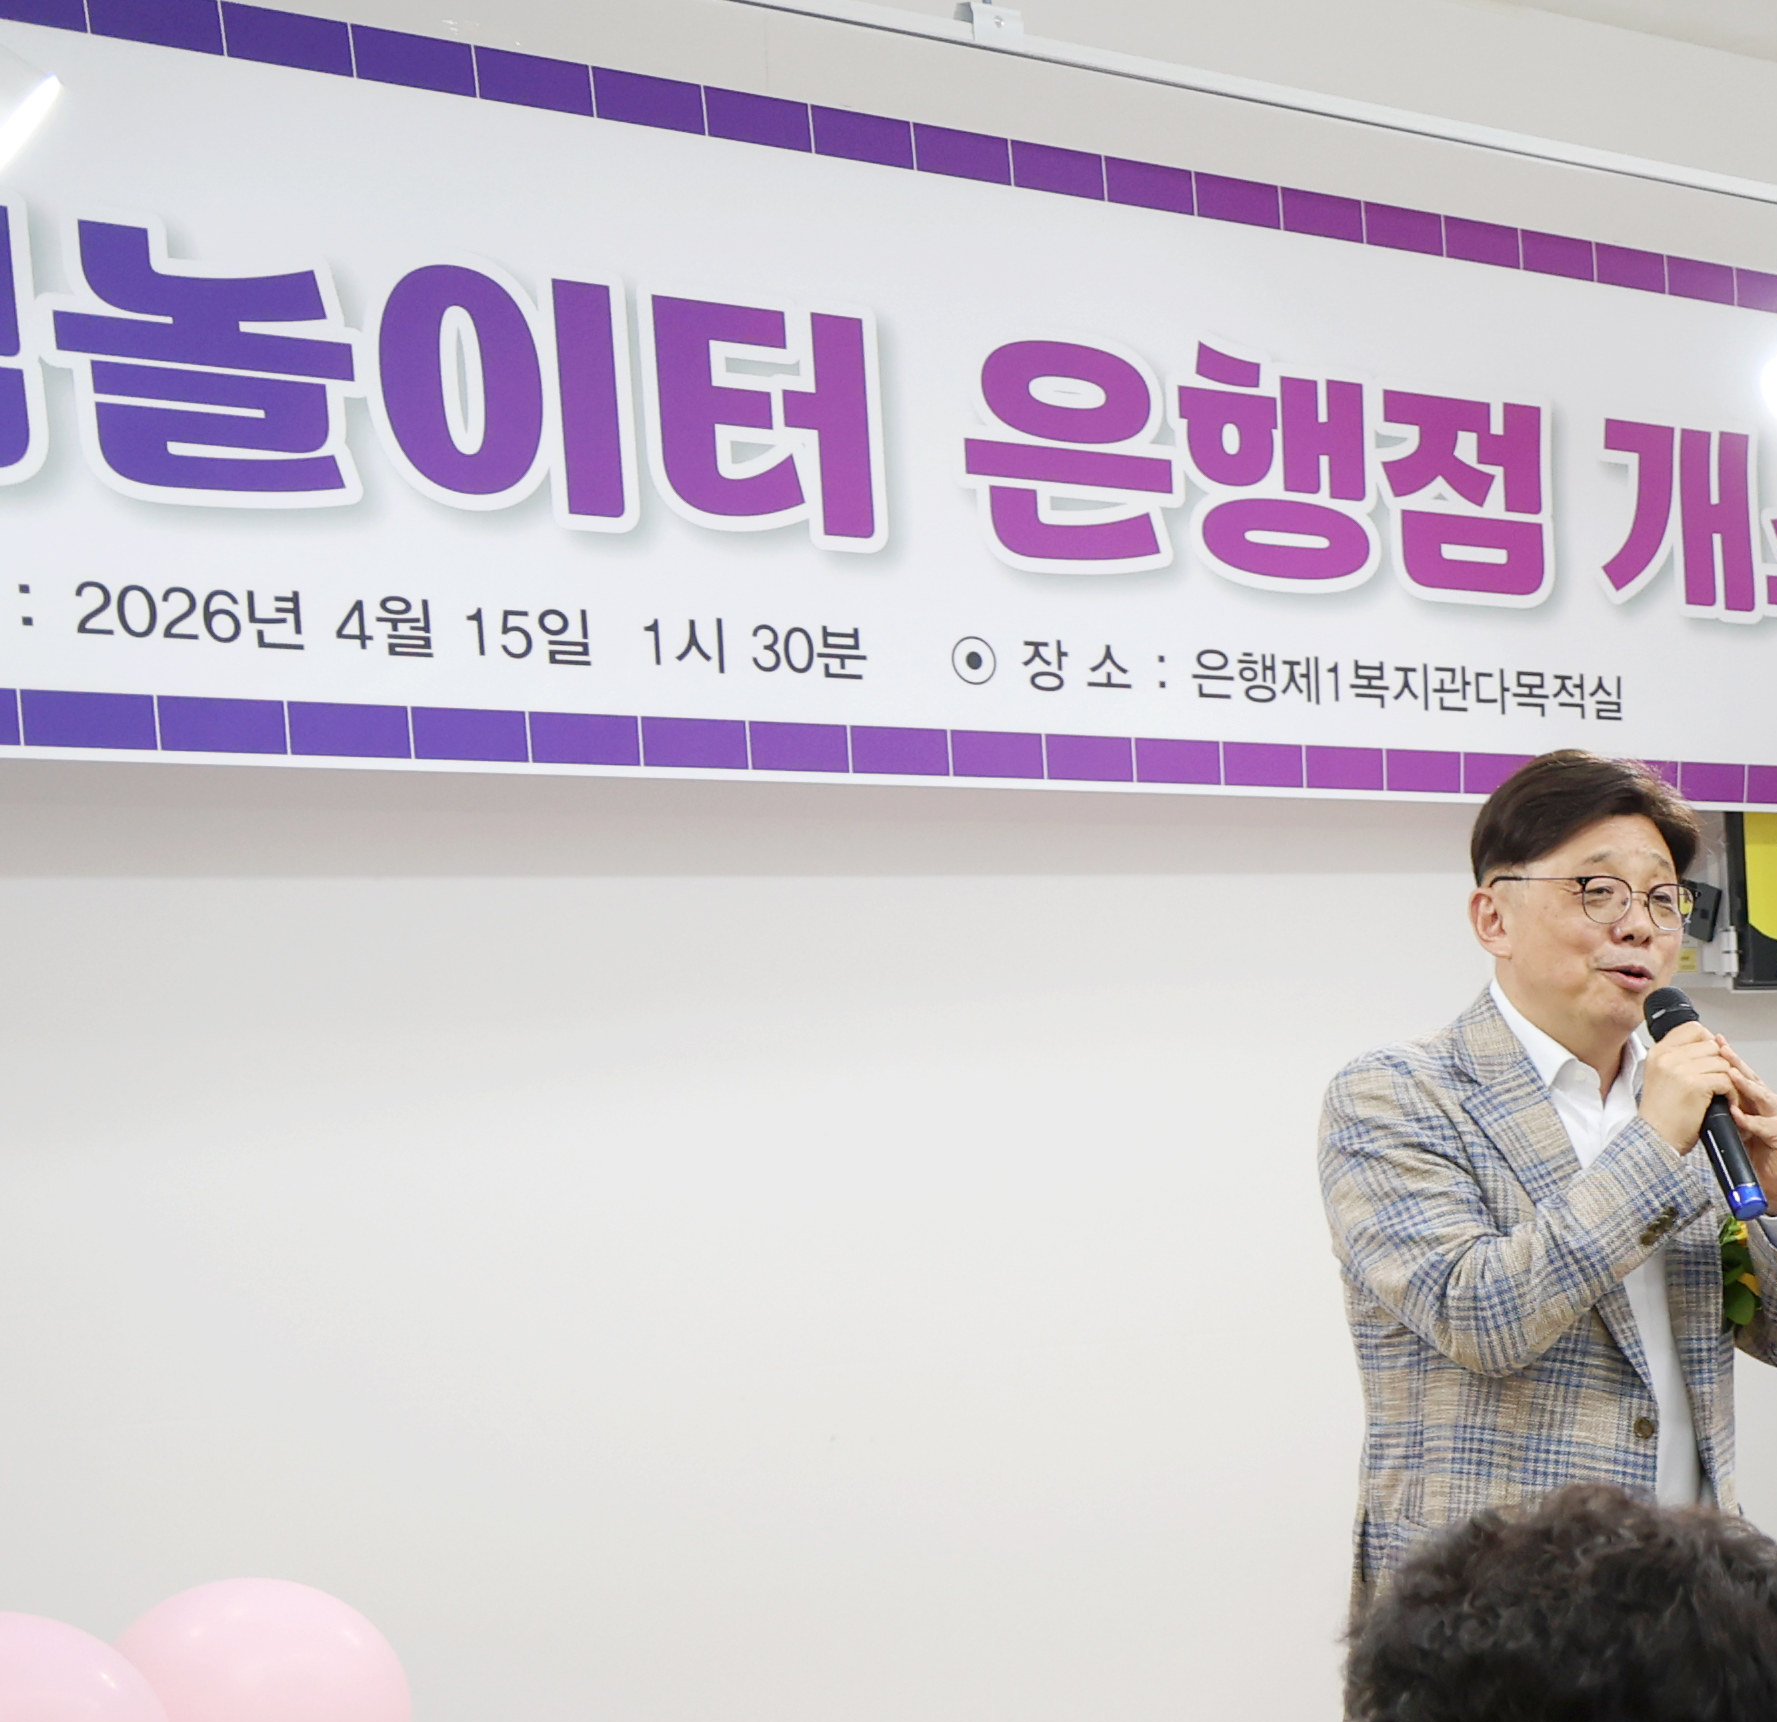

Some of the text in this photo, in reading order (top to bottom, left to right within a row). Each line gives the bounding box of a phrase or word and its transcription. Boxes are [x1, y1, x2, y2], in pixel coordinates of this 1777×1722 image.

[0, 203, 877, 541] 놀이터
[963, 338, 1546, 597] 은행점
[74, 580, 305, 651] 2026년
[335, 595, 434, 659] 4월
[465, 606, 593, 667] 15일
[643, 616, 727, 675] 1시
[750, 623, 868, 681] 30분
[1190, 647, 1624, 722] 은행제1복지관다목적실
